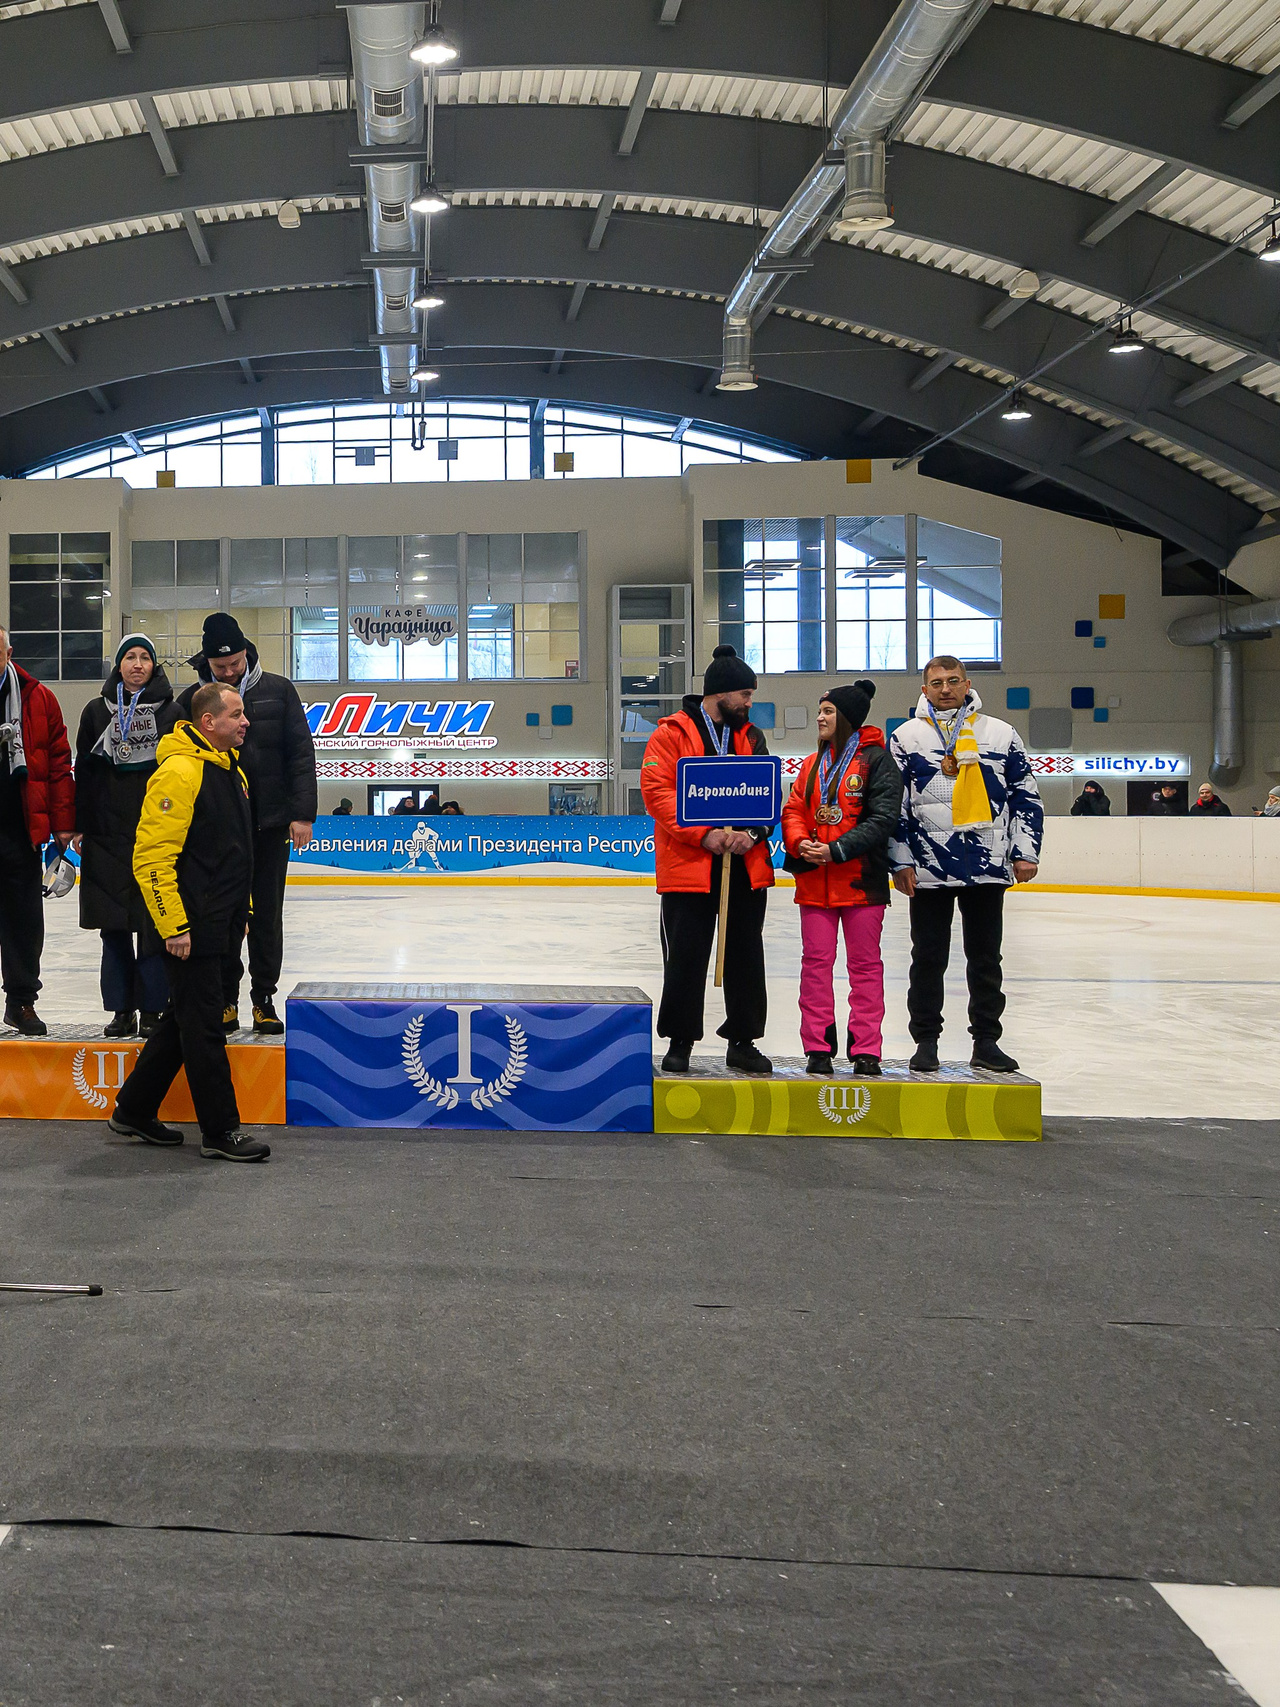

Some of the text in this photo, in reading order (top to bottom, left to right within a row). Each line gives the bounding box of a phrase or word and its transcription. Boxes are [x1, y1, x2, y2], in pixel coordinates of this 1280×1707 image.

[385, 608, 422, 618] КАФЕ
[361, 737, 456, 748] ГОРНОЛЫЖНЫЙ
[458, 738, 495, 749] ЦЕНТР
[1084, 757, 1180, 773] silichy.by
[687, 781, 770, 801] Агрохолдинг
[391, 838, 462, 859] делами
[468, 835, 583, 858] Президента
[588, 836, 655, 860] Респуб
[150, 870, 168, 917] BELARUS
[446, 1004, 483, 1084] I
[92, 1051, 130, 1089] II
[826, 1086, 861, 1110] III
